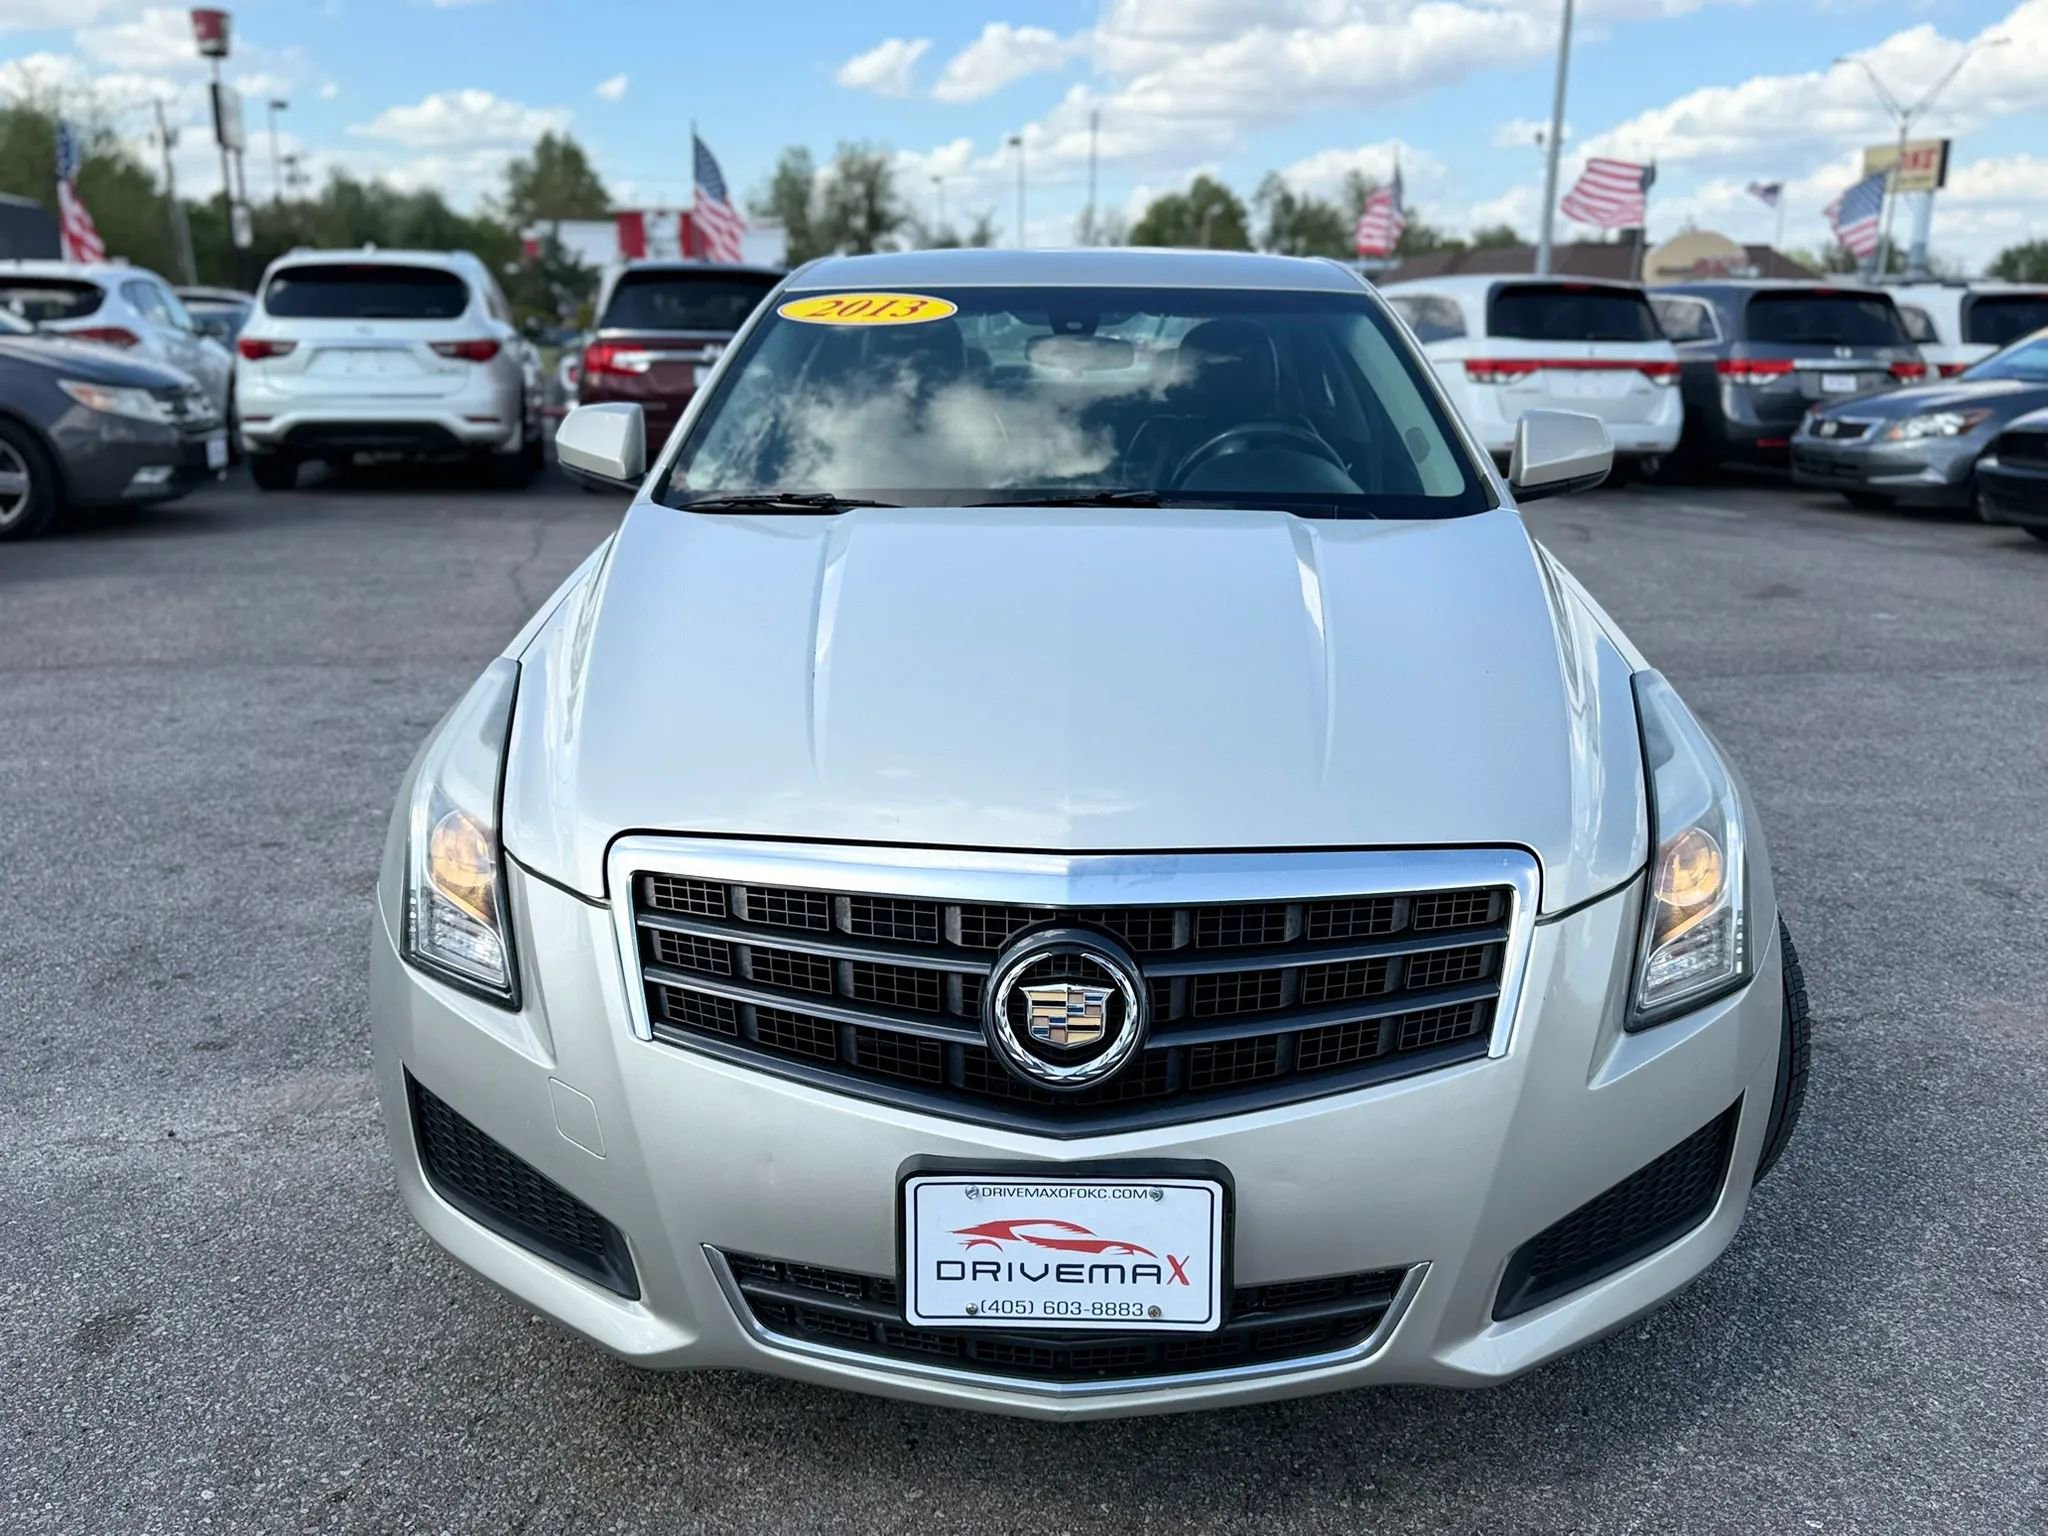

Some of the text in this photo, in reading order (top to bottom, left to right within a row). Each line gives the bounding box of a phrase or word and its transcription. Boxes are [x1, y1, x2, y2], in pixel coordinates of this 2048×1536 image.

[805, 299, 929, 318] 2013
[981, 1186, 1148, 1200] DRIVEMAXOFOKC.COM
[936, 1254, 1190, 1286] DRIVEMAX
[980, 1299, 1144, 1317] (405) 603-8883
